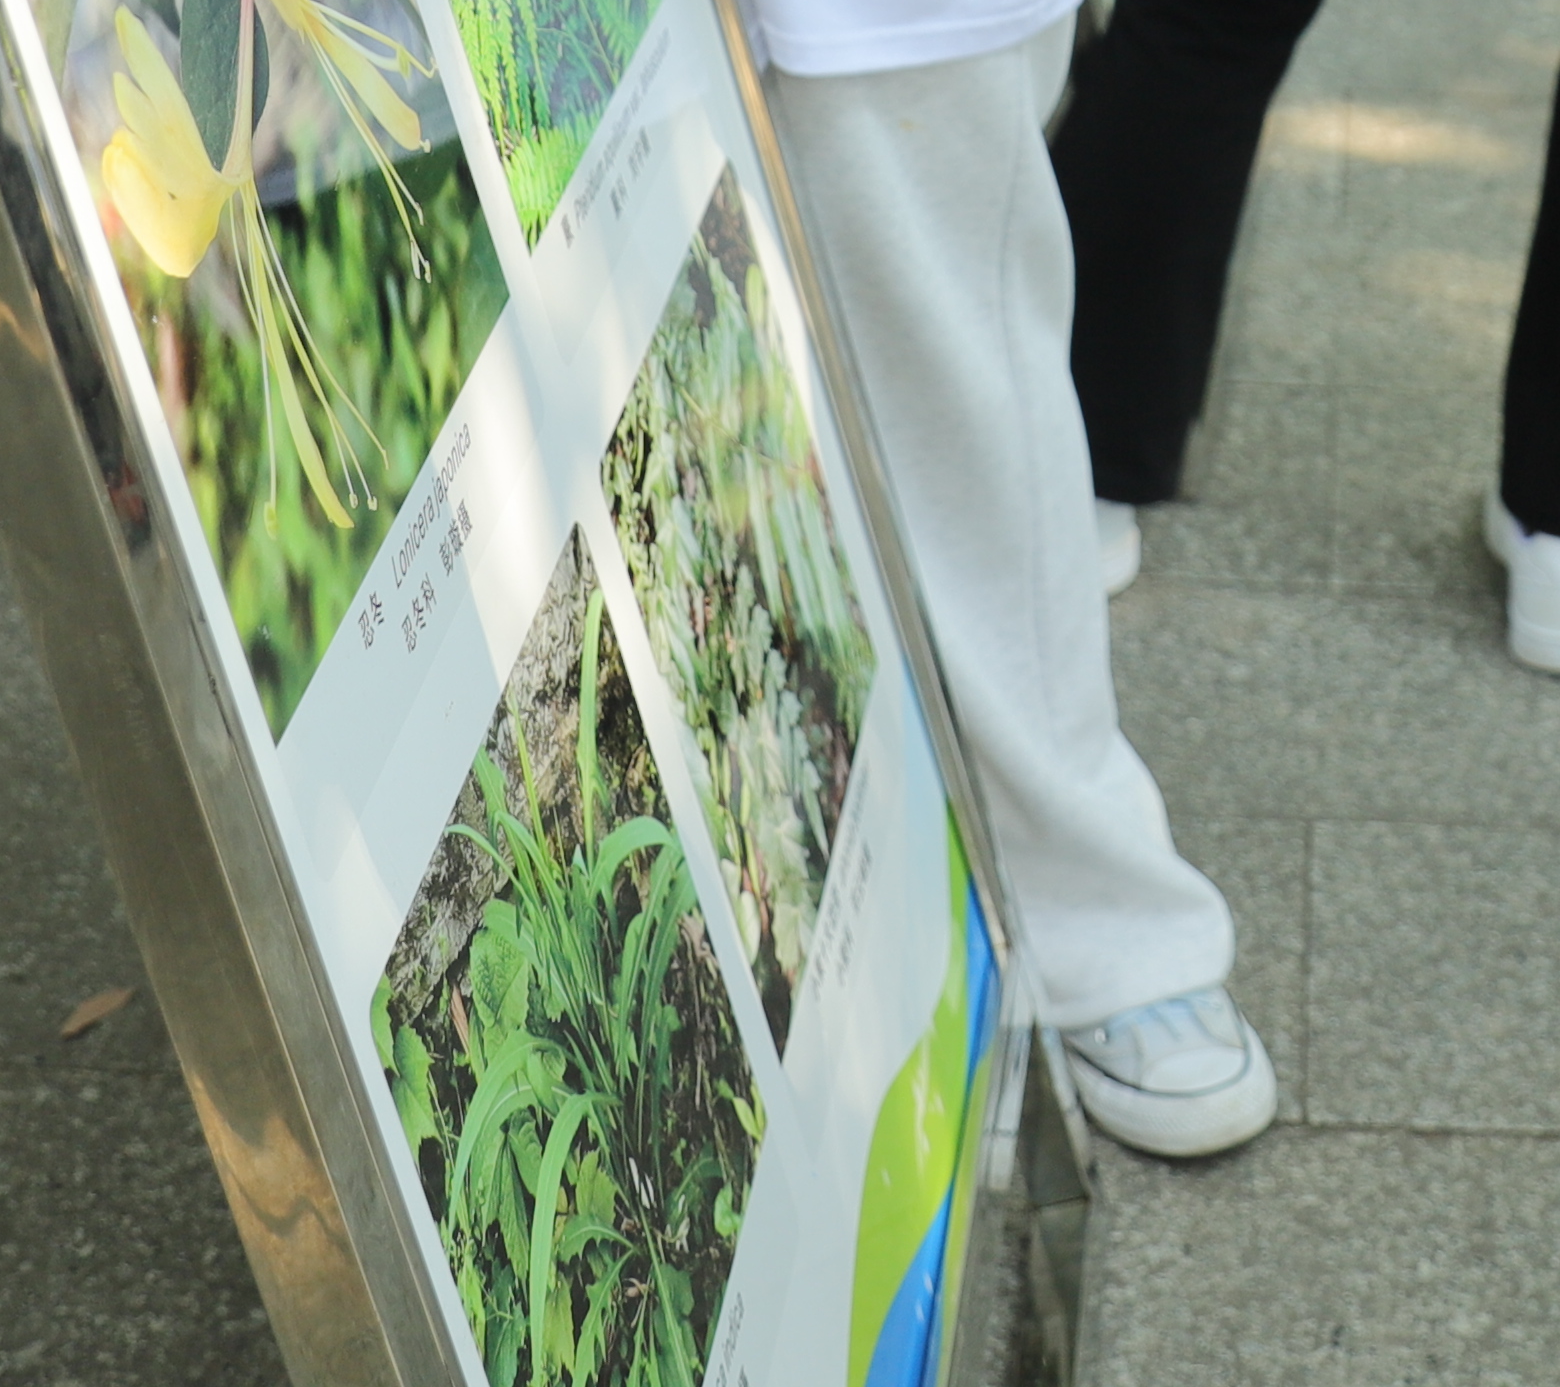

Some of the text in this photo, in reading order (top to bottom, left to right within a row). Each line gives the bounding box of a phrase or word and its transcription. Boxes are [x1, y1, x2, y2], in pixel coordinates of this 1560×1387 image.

[358, 423, 471, 650] 忍冬 Lonicera japonica
[401, 572, 437, 654] 忍冬科
